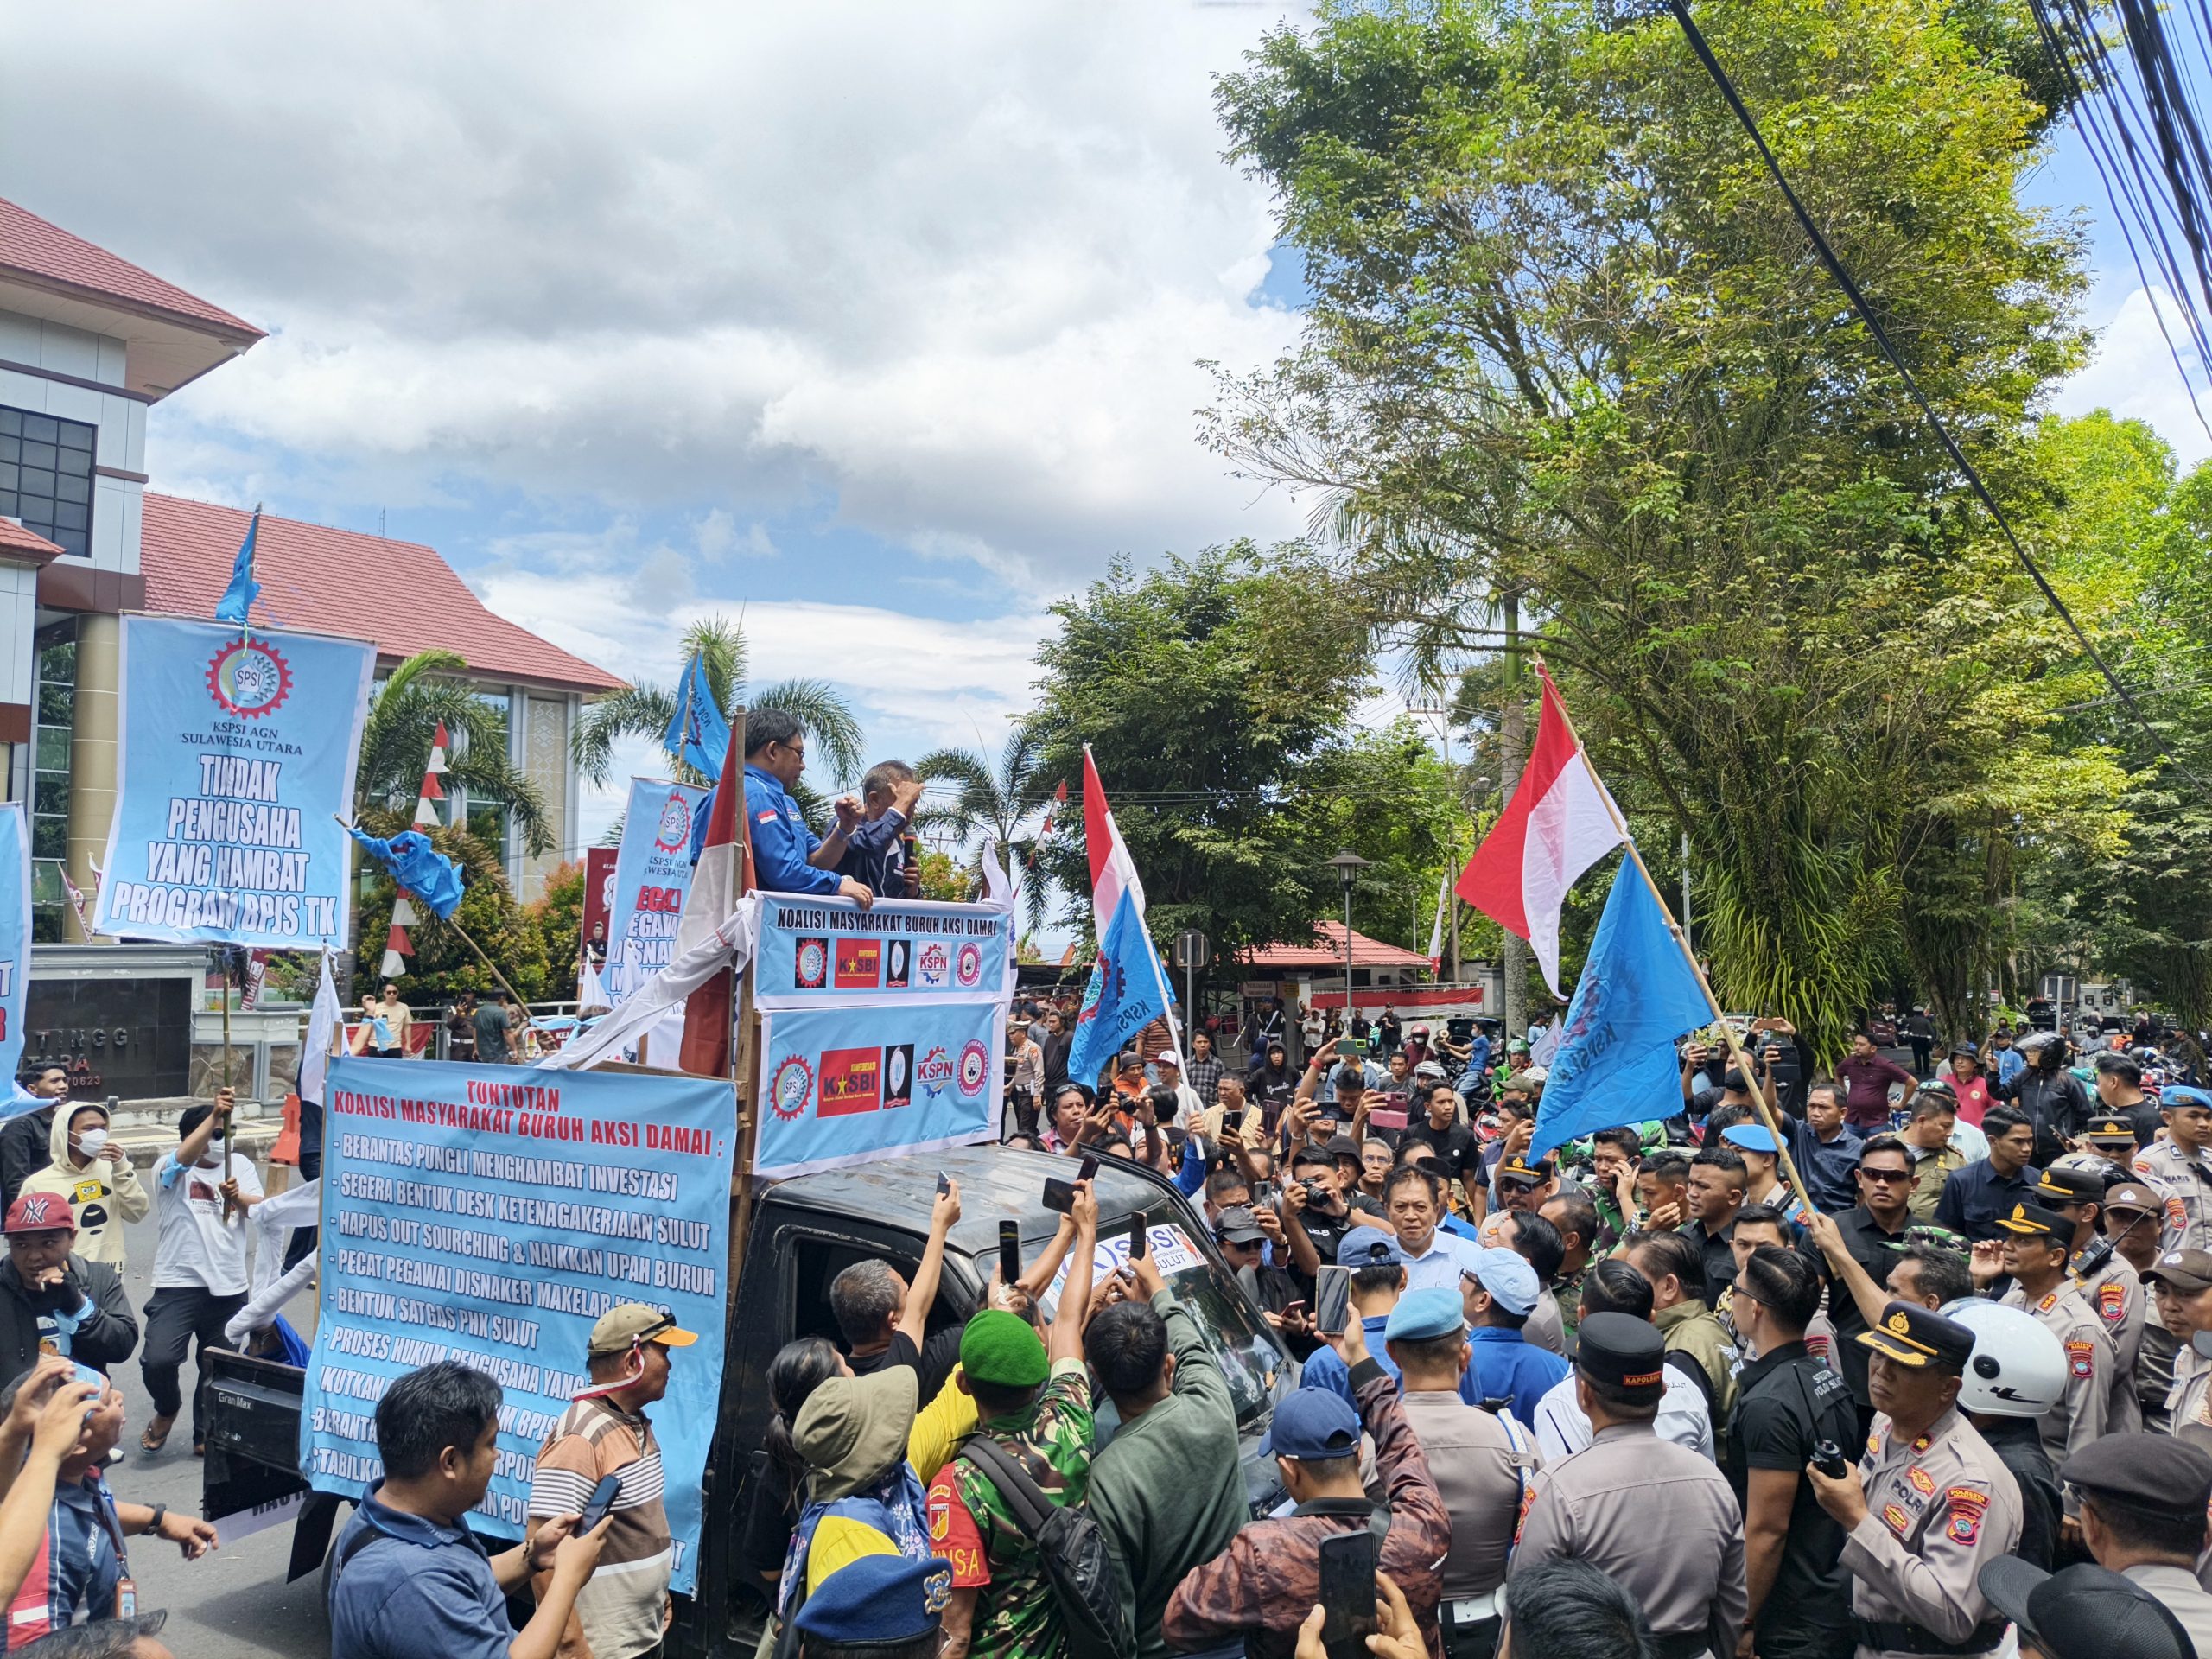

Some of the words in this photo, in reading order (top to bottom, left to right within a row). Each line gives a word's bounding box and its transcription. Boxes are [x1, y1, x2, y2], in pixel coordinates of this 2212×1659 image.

[237, 669, 262, 687] SPSI
[181, 732, 253, 749] SULAWESIA
[257, 741, 303, 756] UTARA
[213, 721, 246, 734] KSPSI
[249, 726, 279, 740] AGN
[198, 753, 282, 803] TINDAK
[167, 798, 302, 849] PENGUSAHA
[146, 842, 213, 887] YANG
[214, 846, 311, 893] HAMBAT
[110, 880, 239, 931] PROGRAM
[244, 893, 301, 937] BPJS
[303, 896, 338, 937] TK
[777, 908, 826, 930] KOALISI
[830, 911, 903, 933] MASYARAKAT
[905, 915, 939, 935] BURUH
[942, 918, 964, 936] AKSI
[967, 918, 997, 938] DAMAI
[919, 956, 948, 969] KSPN
[35, 1027, 139, 1049] TINGGI
[917, 1061, 954, 1080] KSPN
[467, 1080, 560, 1113] TUNTUTAN
[334, 1090, 397, 1120] KOALISI
[400, 1098, 514, 1135] MASYARAKAT
[518, 1111, 584, 1142] BURUH
[590, 1119, 639, 1147] AKSI
[646, 1123, 712, 1156] DAMAI
[342, 1132, 414, 1167] BERANTAS
[416, 1143, 469, 1175] PUNGLI
[472, 1149, 586, 1190] MENGHAMBAT
[588, 1163, 678, 1203] INVESTASI
[340, 1171, 394, 1203] SEGERA
[396, 1179, 454, 1213] BENTUK
[455, 1187, 496, 1219] DESK
[498, 1194, 654, 1242] KETENAGAKERJAAN
[657, 1215, 711, 1251] SULUT
[339, 1210, 388, 1242] HAPUS
[390, 1217, 421, 1247] OUT
[422, 1222, 510, 1263] SOURCHING
[512, 1242, 526, 1265] &
[527, 1239, 604, 1277] NAIKKAN
[606, 1250, 651, 1286] UPAH
[653, 1258, 715, 1297] BURUH
[337, 1248, 385, 1279] PECAT
[386, 1255, 453, 1292] PEGAWAI
[454, 1267, 534, 1306] DISNAKER
[536, 1281, 613, 1319] MAKELAR
[337, 1286, 396, 1320] BENTUK
[398, 1296, 457, 1332] SATGAS
[458, 1307, 489, 1339] PHK
[491, 1314, 540, 1350] SULUT
[328, 1325, 391, 1361] PROSES
[390, 1336, 448, 1368] HUKUM
[448, 1346, 541, 1395] PENGUSAHA
[542, 1367, 587, 1402] YANG
[516, 1406, 561, 1442] BPJS
